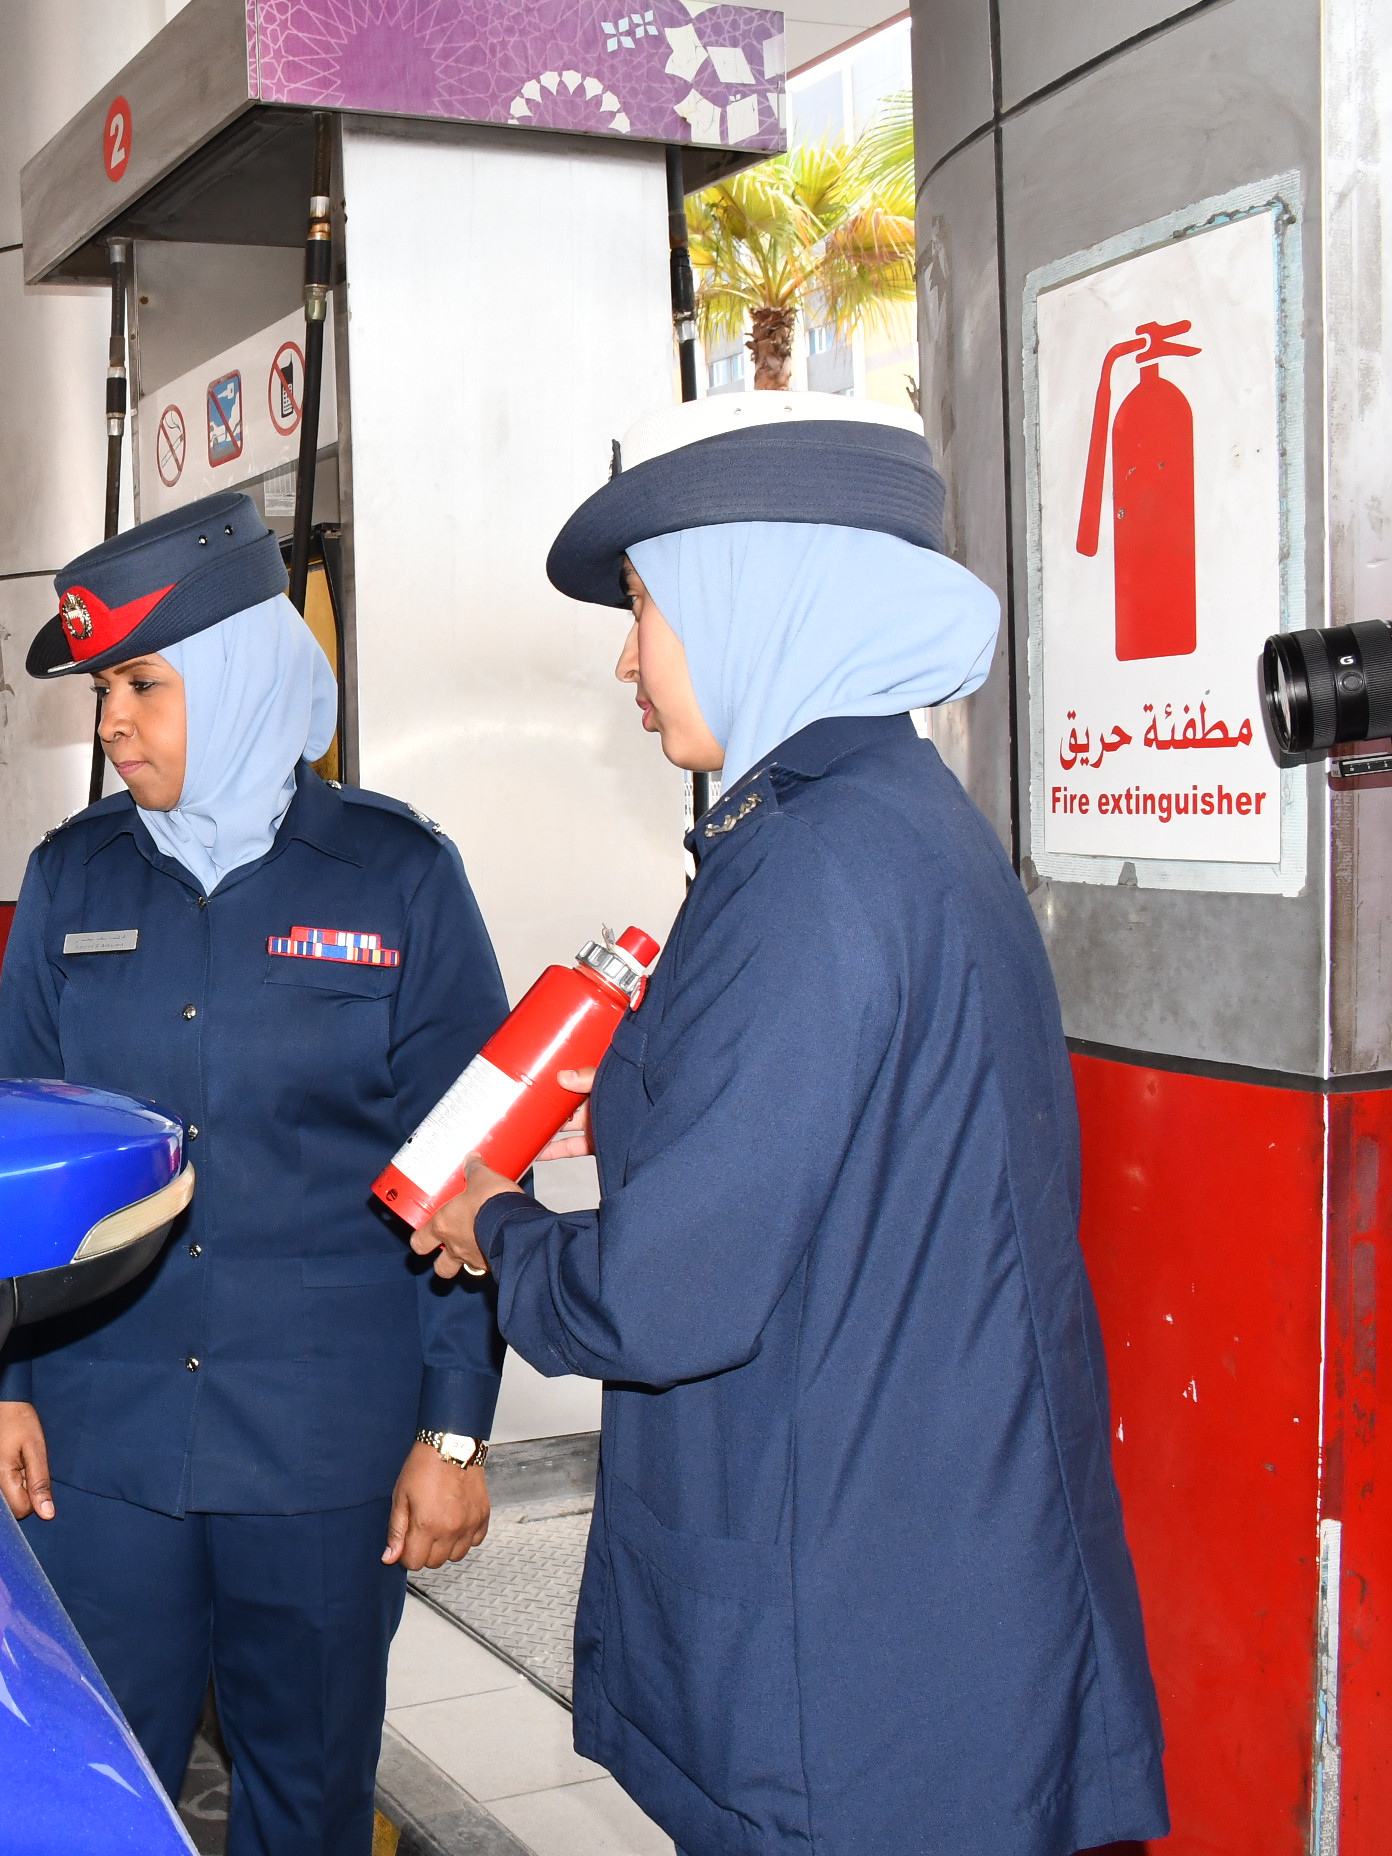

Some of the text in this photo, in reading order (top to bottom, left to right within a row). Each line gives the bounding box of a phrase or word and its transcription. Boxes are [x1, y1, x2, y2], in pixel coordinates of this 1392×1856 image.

[110, 113, 125, 170] 2
[1340, 656, 1355, 665] G
[1059, 699, 1253, 770] مطفئة حريق
[1051, 784, 1267, 823] Fire extinguisher
